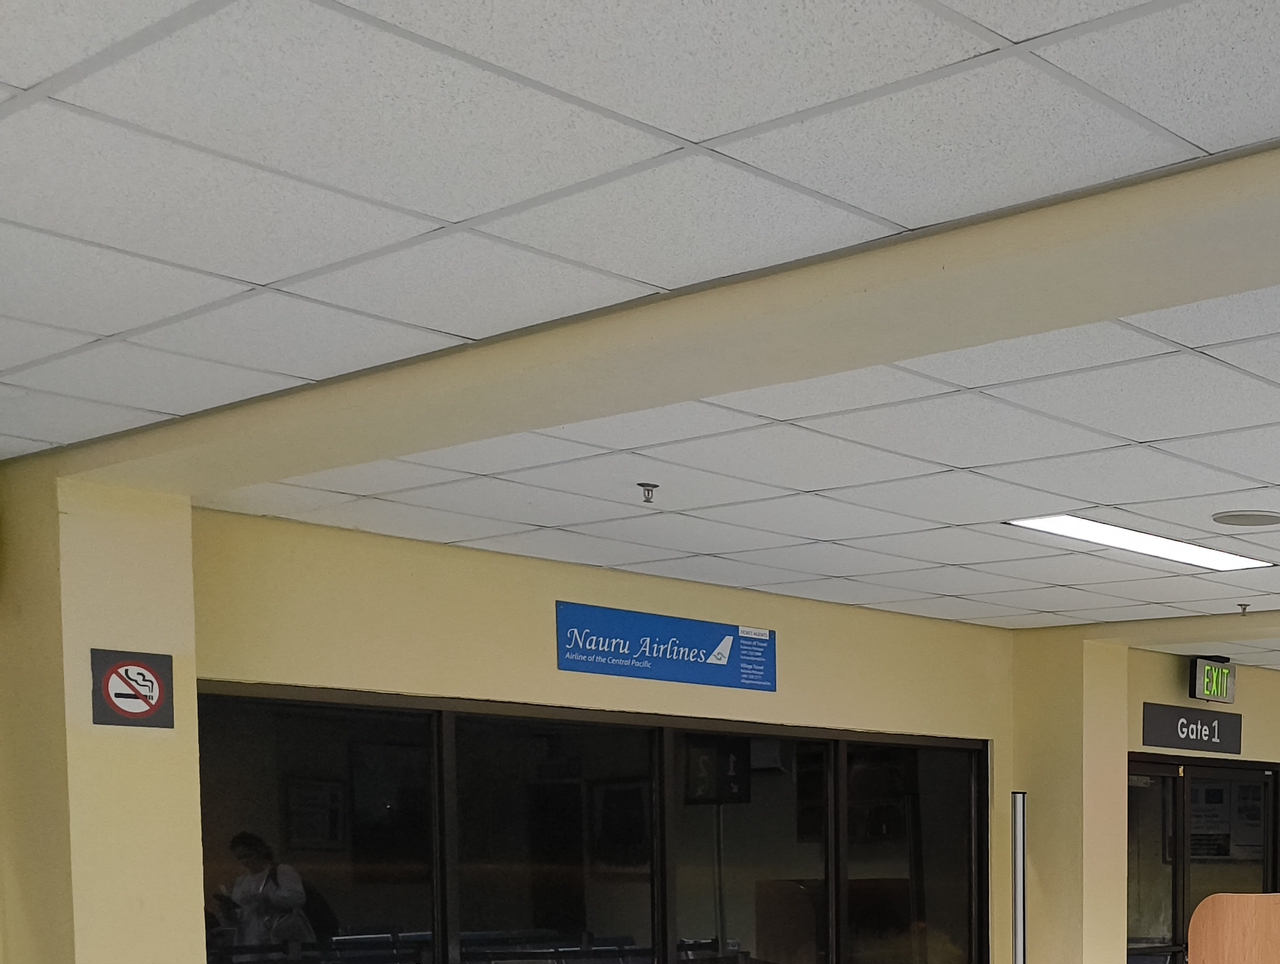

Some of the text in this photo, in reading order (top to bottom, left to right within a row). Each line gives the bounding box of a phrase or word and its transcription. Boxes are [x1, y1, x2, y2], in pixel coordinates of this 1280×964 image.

[565, 628, 707, 663] Nauru Airlines
[565, 651, 587, 661] Airline
[596, 655, 606, 663] the
[607, 656, 630, 666] Central
[631, 659, 652, 668] Pacific
[1204, 665, 1230, 698] EXIT
[1177, 718, 1220, 743] Gate 1
